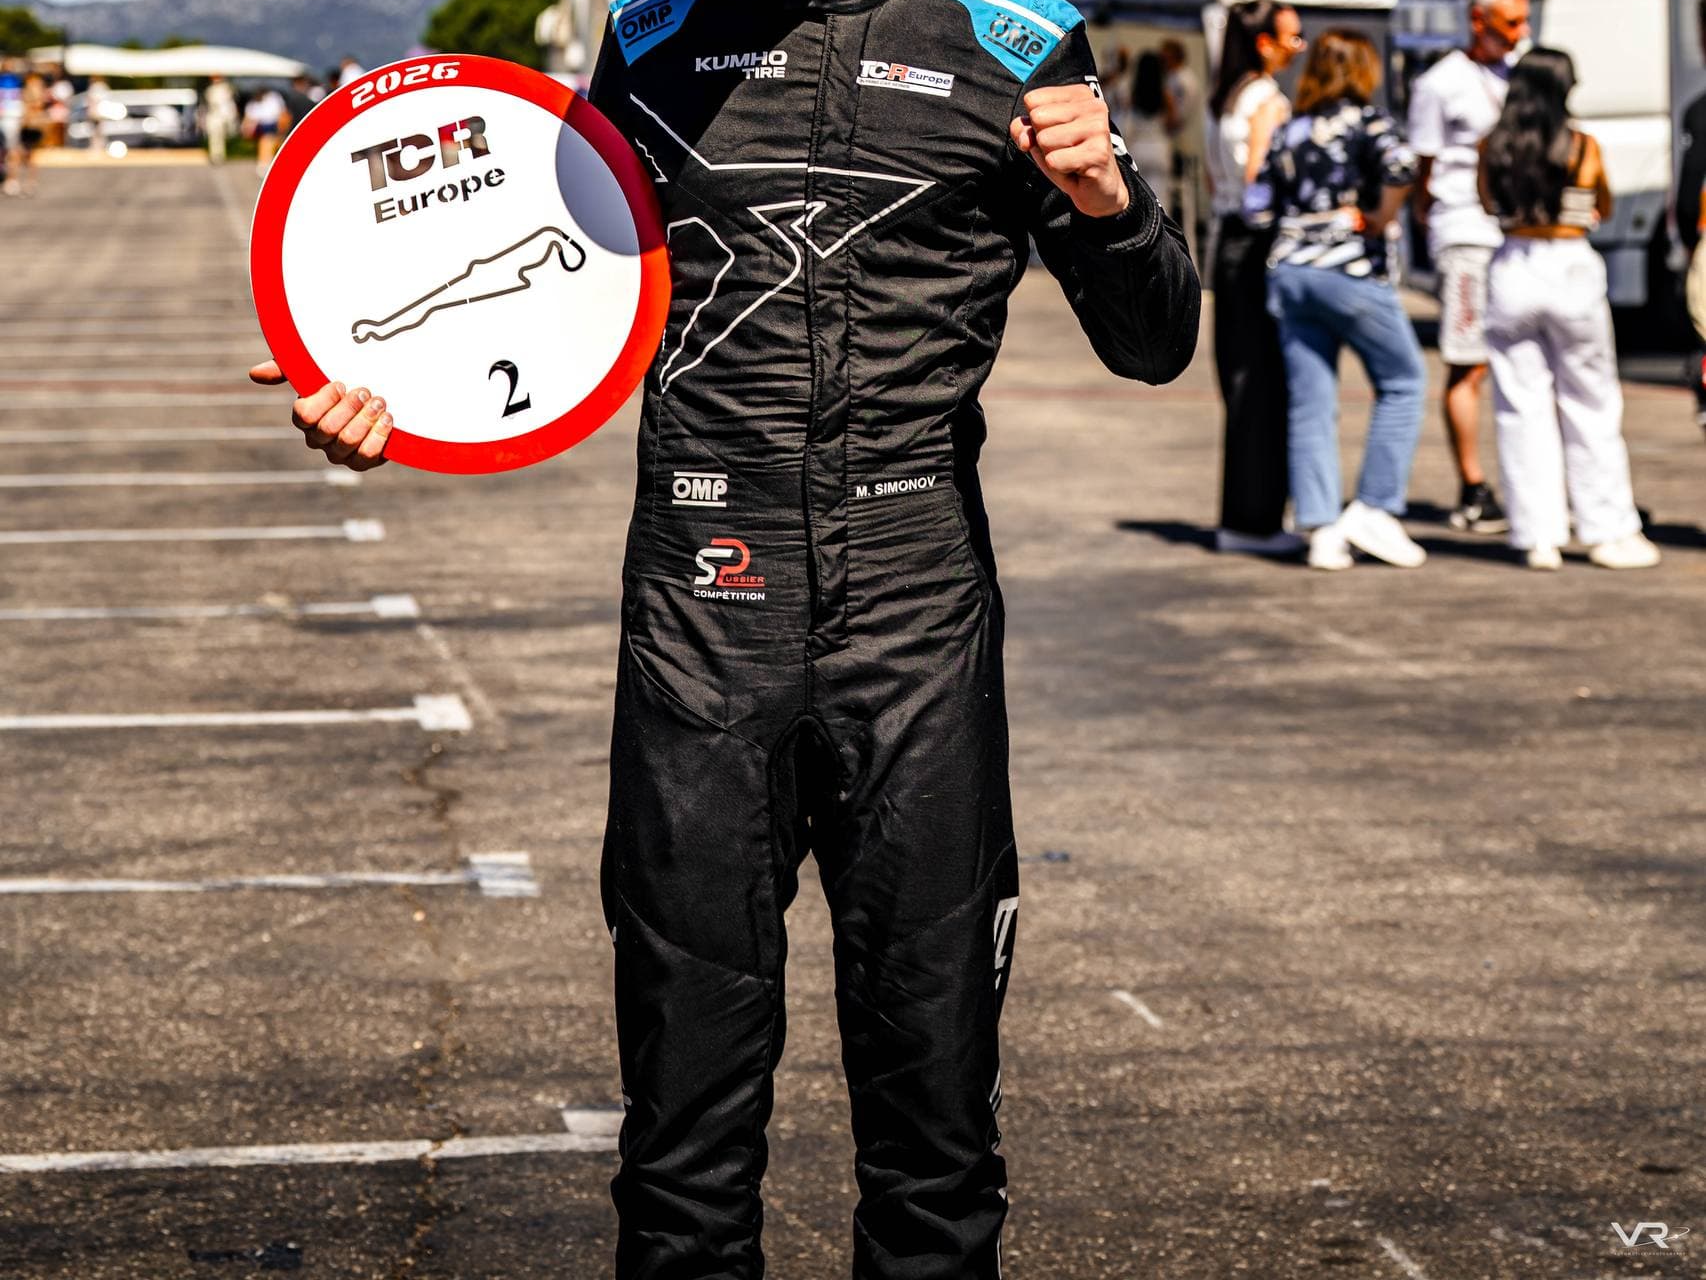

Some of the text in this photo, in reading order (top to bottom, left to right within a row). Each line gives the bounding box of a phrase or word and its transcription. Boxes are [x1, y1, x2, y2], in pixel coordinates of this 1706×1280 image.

[621, 4, 673, 39] OMP
[989, 19, 1044, 57] OMP
[695, 49, 788, 72] KUMHO
[742, 66, 786, 80] TIRE
[860, 60, 909, 82] TCR
[908, 71, 951, 86] Europe
[350, 62, 461, 110] 2026
[350, 116, 491, 192] TCR
[373, 168, 506, 224] Europe
[488, 360, 531, 418] 2
[672, 477, 728, 501] OMP
[856, 475, 936, 498] M. SIMONOV
